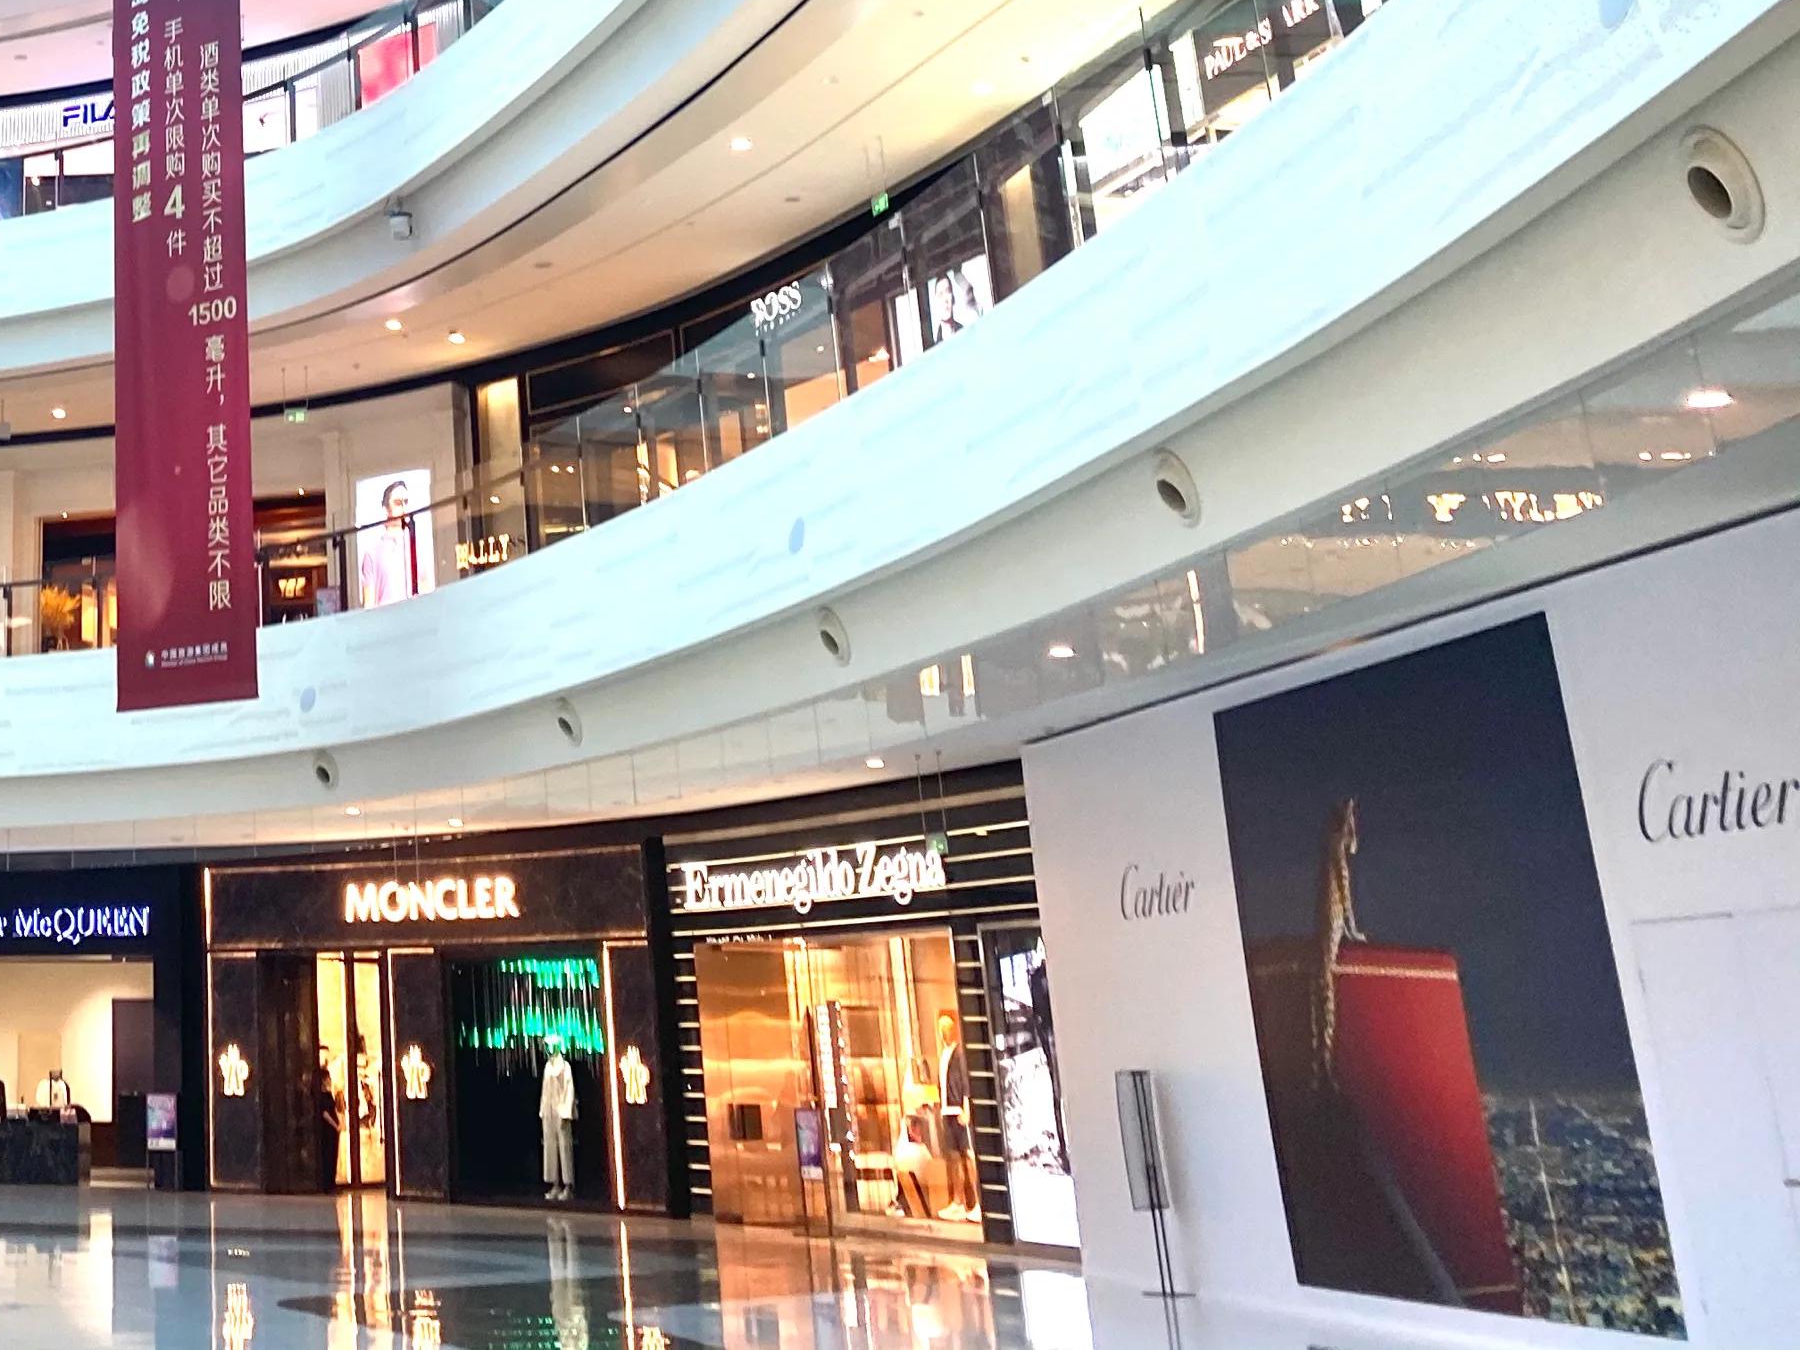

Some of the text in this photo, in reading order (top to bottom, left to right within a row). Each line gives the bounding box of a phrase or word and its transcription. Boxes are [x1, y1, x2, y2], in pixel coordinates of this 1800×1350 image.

[1639, 759, 1800, 842] Cartier
[345, 876, 520, 923] MONCLER
[681, 842, 946, 914] Ermenegildo Zegna
[1120, 863, 1195, 920] Cartier
[13, 906, 150, 945] McQUEEN
